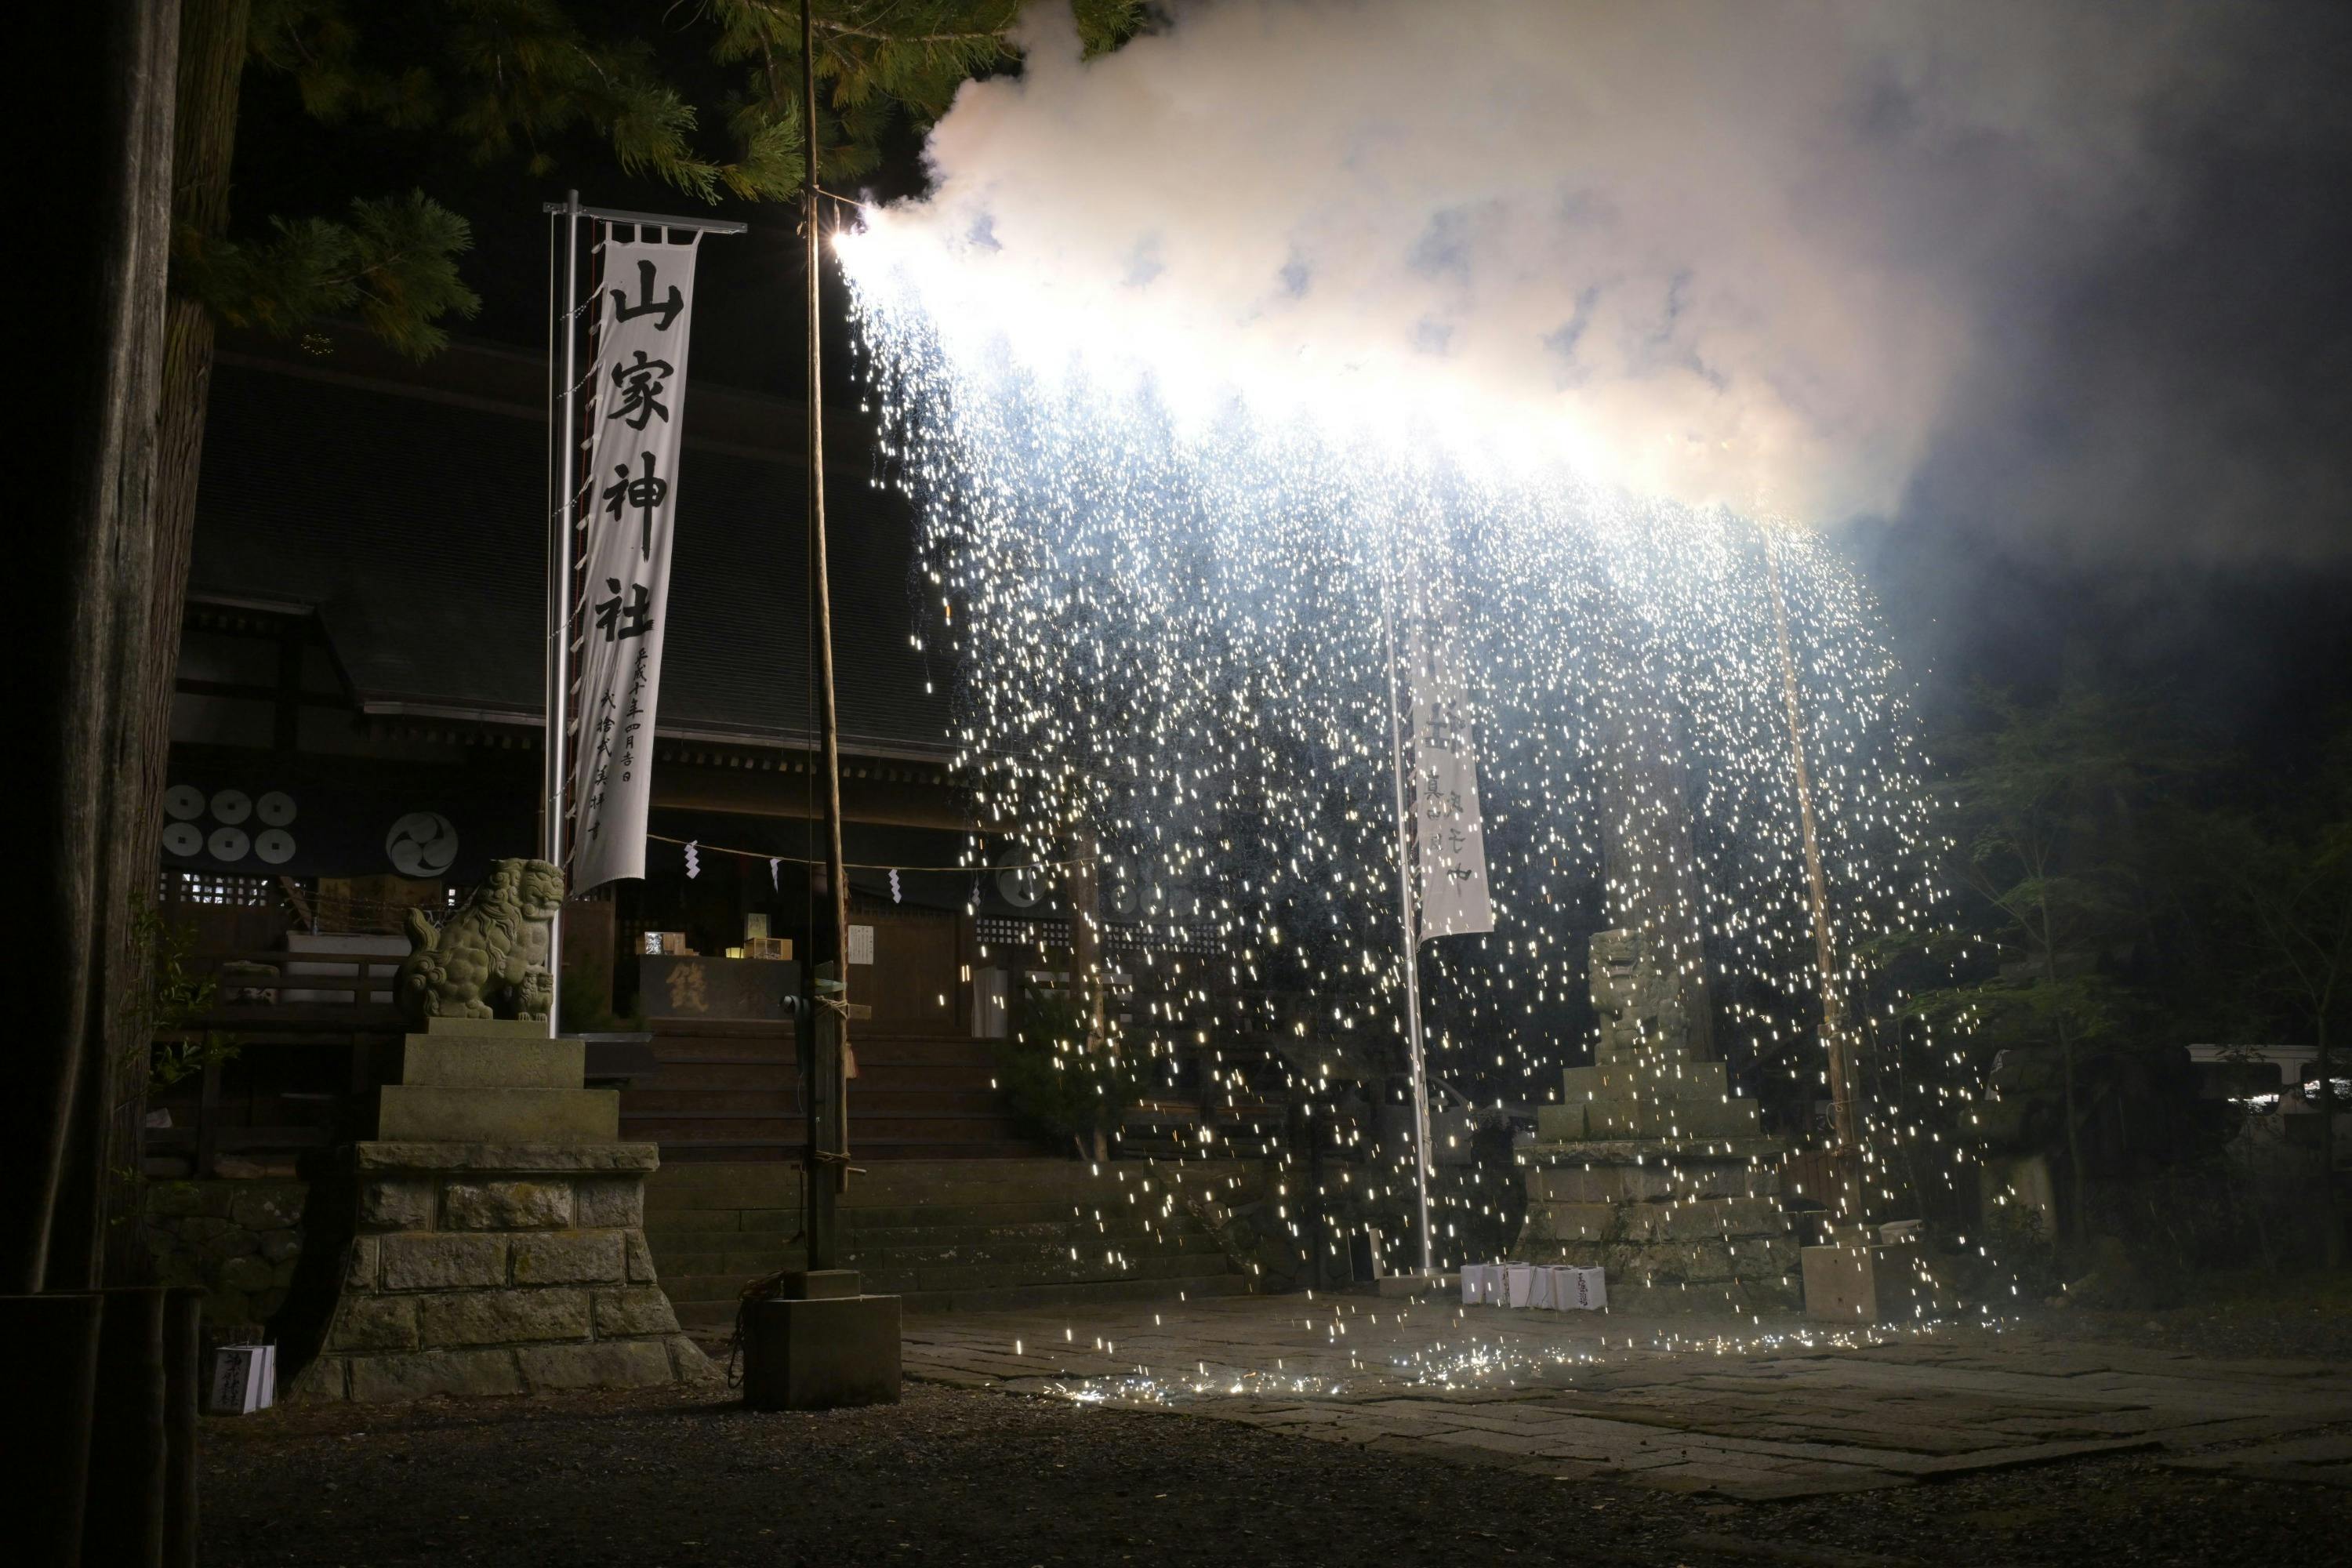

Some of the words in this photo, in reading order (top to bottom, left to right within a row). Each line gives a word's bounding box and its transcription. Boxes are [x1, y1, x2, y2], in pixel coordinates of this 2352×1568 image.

[595, 259, 684, 643] 山家神社
[620, 647, 649, 782] 平成十年四月吉日
